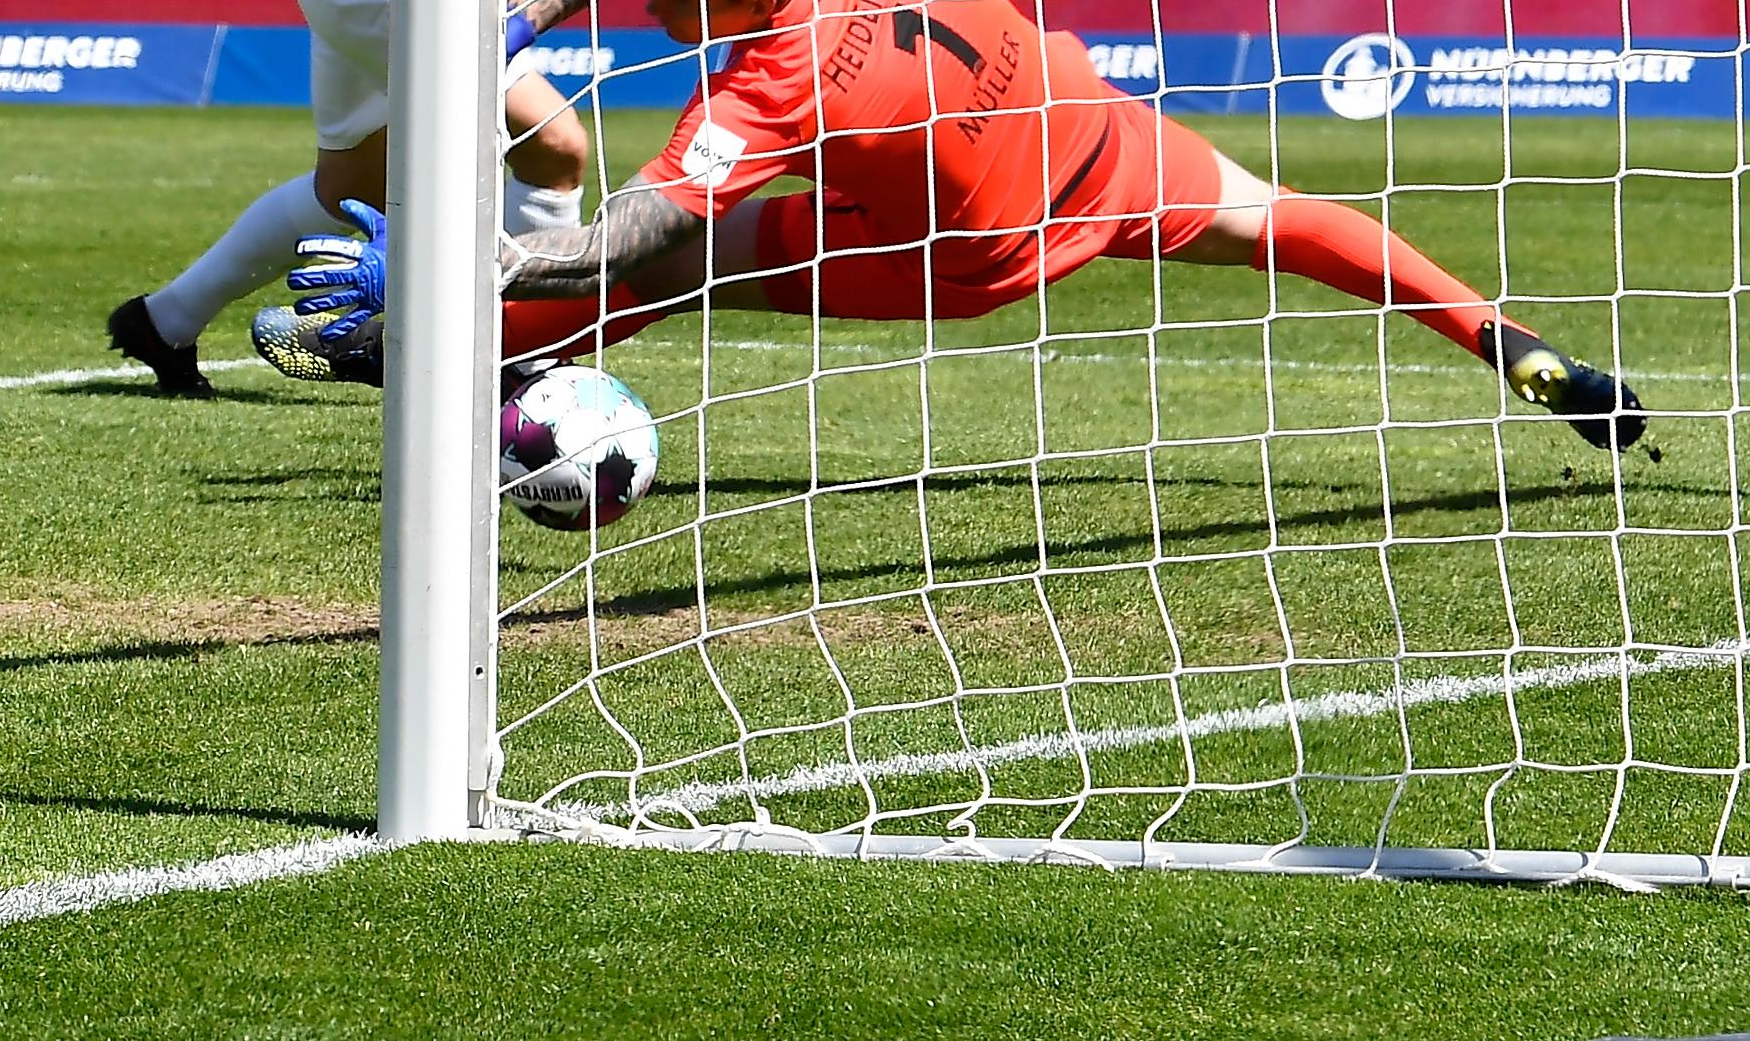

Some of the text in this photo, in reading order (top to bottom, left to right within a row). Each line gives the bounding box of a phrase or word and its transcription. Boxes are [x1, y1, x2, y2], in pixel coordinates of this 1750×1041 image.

[893, 3, 988, 80] 1
[1428, 46, 1695, 82] NÜRNBERGER
[957, 31, 1020, 144] MÜLLER
